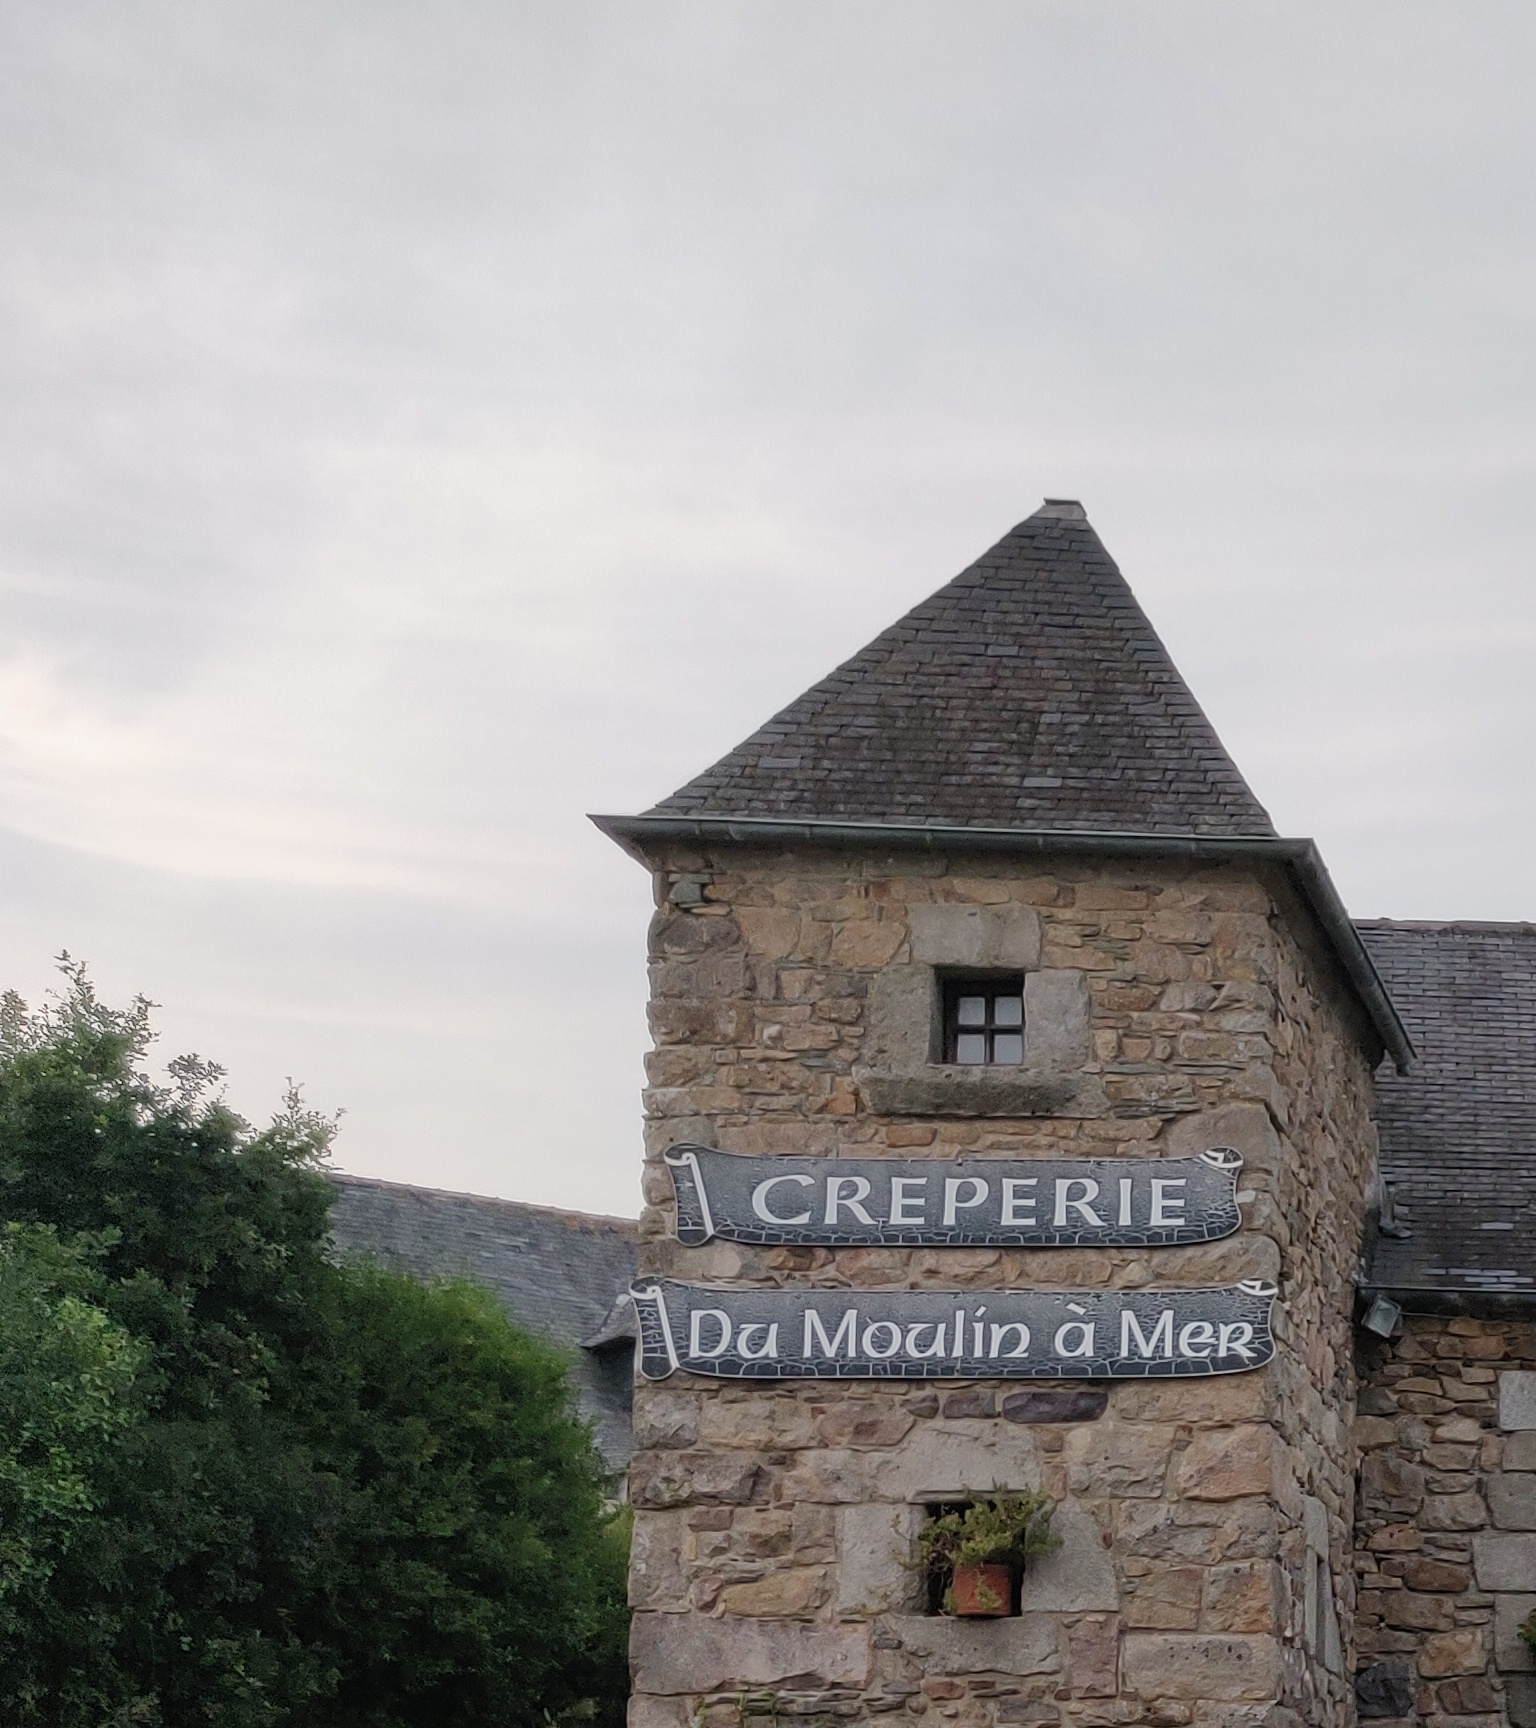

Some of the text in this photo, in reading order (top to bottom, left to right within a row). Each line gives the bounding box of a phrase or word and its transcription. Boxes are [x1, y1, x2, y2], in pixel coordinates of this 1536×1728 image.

[751, 1174, 1188, 1227] CREPERIE
[689, 1309, 779, 1359] Du
[802, 1305, 1031, 1359] Moulin
[1054, 1302, 1096, 1358] à
